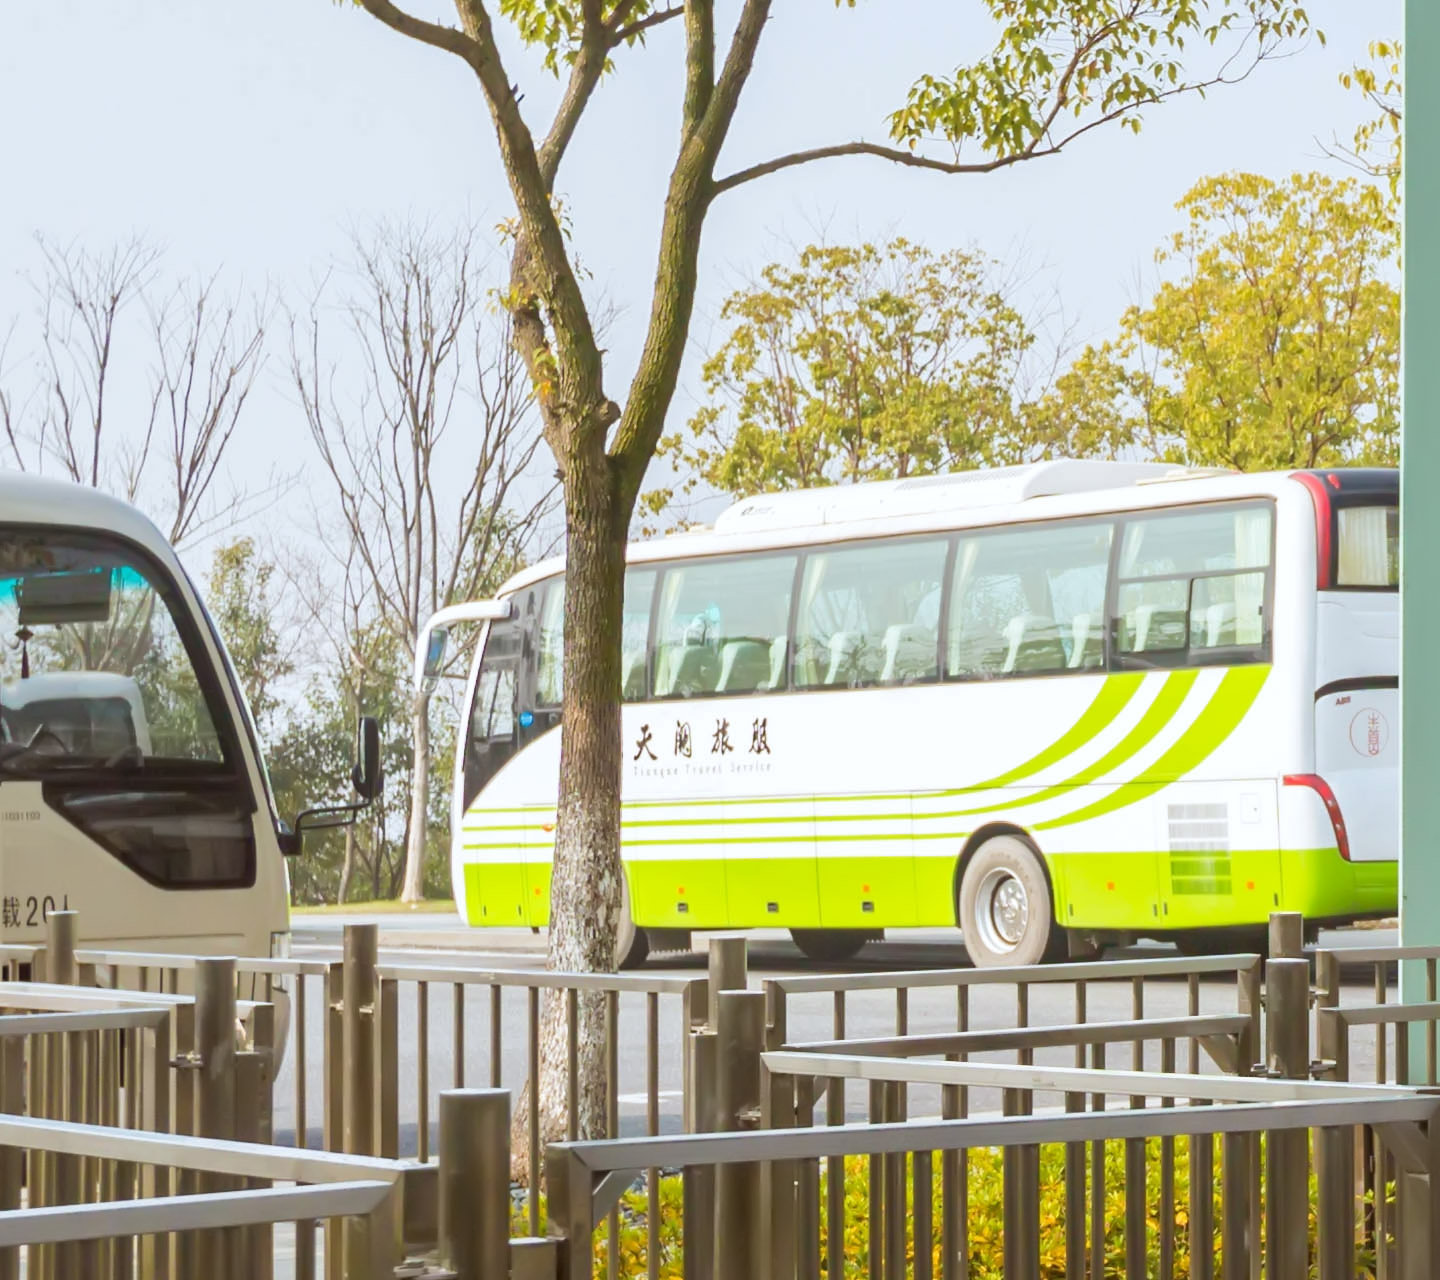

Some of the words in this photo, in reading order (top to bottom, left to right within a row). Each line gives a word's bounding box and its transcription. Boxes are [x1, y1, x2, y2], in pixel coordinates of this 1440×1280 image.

[685, 763, 722, 775] Travel
[730, 760, 772, 773] Service
[2, 894, 69, 928] 载20
